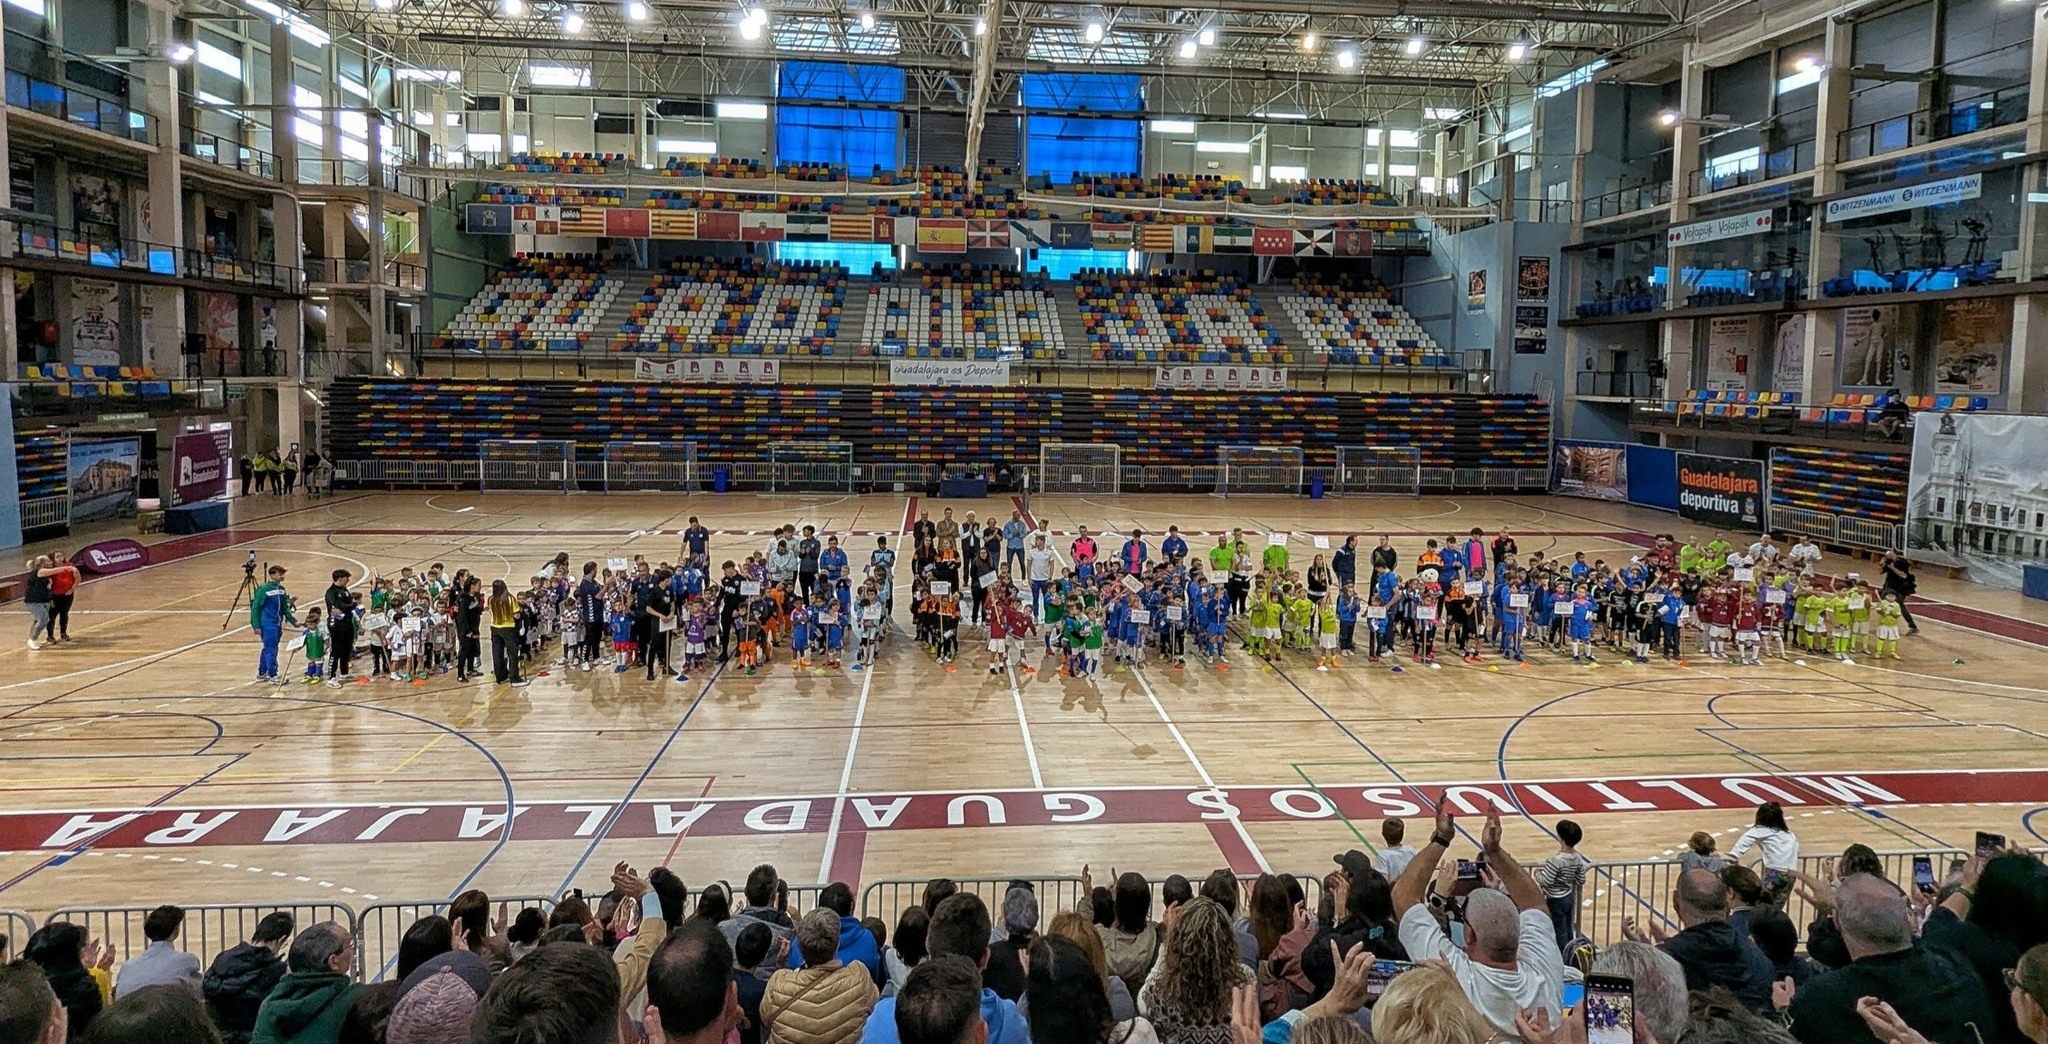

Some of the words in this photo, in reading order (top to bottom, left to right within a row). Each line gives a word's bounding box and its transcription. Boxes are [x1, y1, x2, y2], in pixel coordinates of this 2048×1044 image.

[1913, 178, 1980, 199] WITZENMANN
[1838, 193, 1897, 211] WITZENMANN
[951, 367, 963, 375] es
[964, 361, 1004, 379] Deporte
[1679, 467, 1759, 494] Guadalajara
[1680, 489, 1740, 514] deportiva
[1187, 775, 1906, 822] MULTIUSOS
[41, 791, 1106, 846] GUADALAJARA
